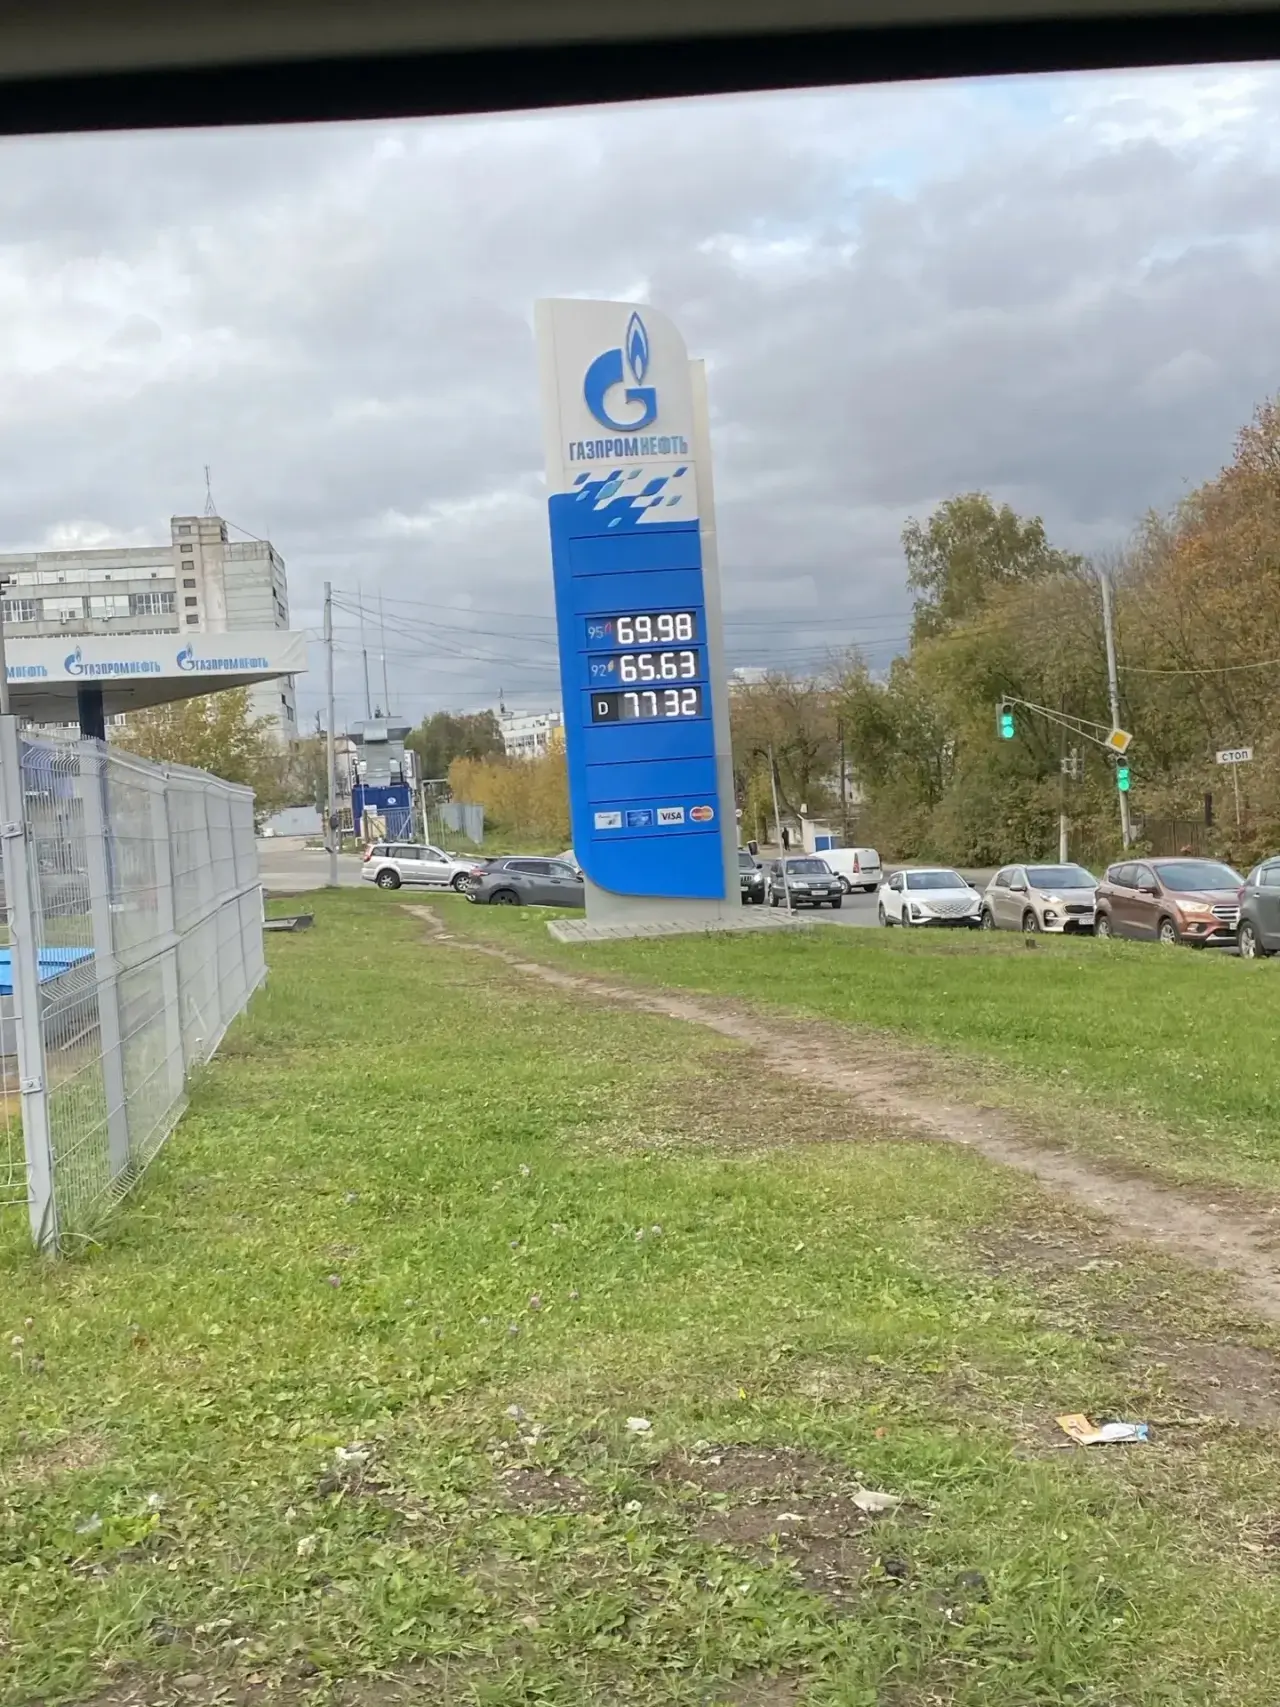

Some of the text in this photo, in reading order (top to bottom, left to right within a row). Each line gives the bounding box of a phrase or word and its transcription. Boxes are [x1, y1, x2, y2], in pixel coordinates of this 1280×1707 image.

[569, 436, 688, 461] ГАЗПРОМНЕФТЬ
[617, 614, 693, 644] 69.98
[591, 651, 696, 682] 92 65.63
[598, 702, 609, 715] D
[1222, 751, 1248, 761] СТОП
[661, 812, 682, 821] VISA
